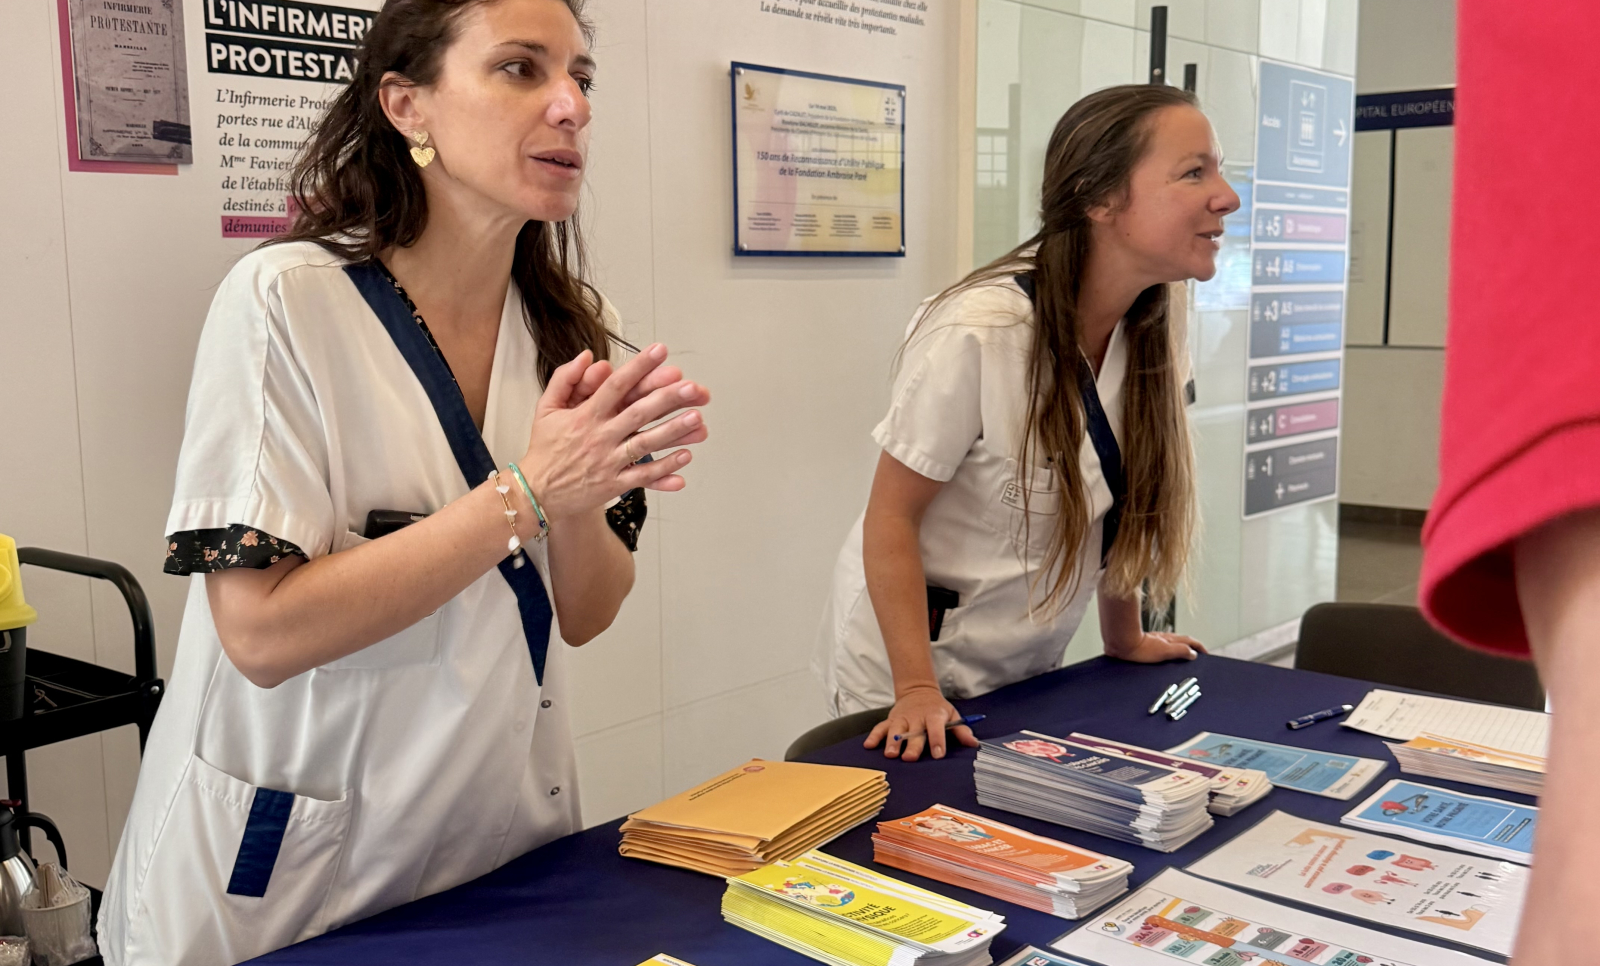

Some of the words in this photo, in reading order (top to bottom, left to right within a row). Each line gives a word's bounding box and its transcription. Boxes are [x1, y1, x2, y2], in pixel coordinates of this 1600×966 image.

[103, 1, 153, 15] INFIRMERIE
[760, 1, 770, 12] La
[771, 3, 803, 19] demande
[805, 12, 812, 20] se
[90, 15, 168, 36] PROTESTANTE
[208, 0, 373, 41] L'INFIRMERI
[210, 42, 359, 81] PROTESTA
[216, 89, 296, 109] L'Infirmerie
[1356, 105, 1388, 118] PITAL
[1391, 100, 1455, 117] EUROPÉEN
[217, 113, 258, 129] portes
[261, 117, 284, 128] rue
[287, 115, 318, 133] d'Alg
[219, 132, 235, 147] de
[238, 133, 251, 148] la
[250, 156, 292, 171] Favier
[756, 151, 769, 160] 150
[781, 153, 789, 163] de
[779, 166, 787, 176] de
[795, 167, 826, 178] Fondation
[222, 176, 238, 190] de
[241, 176, 290, 192] l'établis
[223, 197, 275, 212] destinés
[278, 199, 286, 212] à
[224, 219, 288, 233] démunies
[1264, 300, 1279, 322] +3
[1261, 371, 1277, 393] +2
[1260, 413, 1274, 435] +1
[842, 902, 880, 918] CTIVITÉ
[857, 905, 896, 921] YSIQUE
